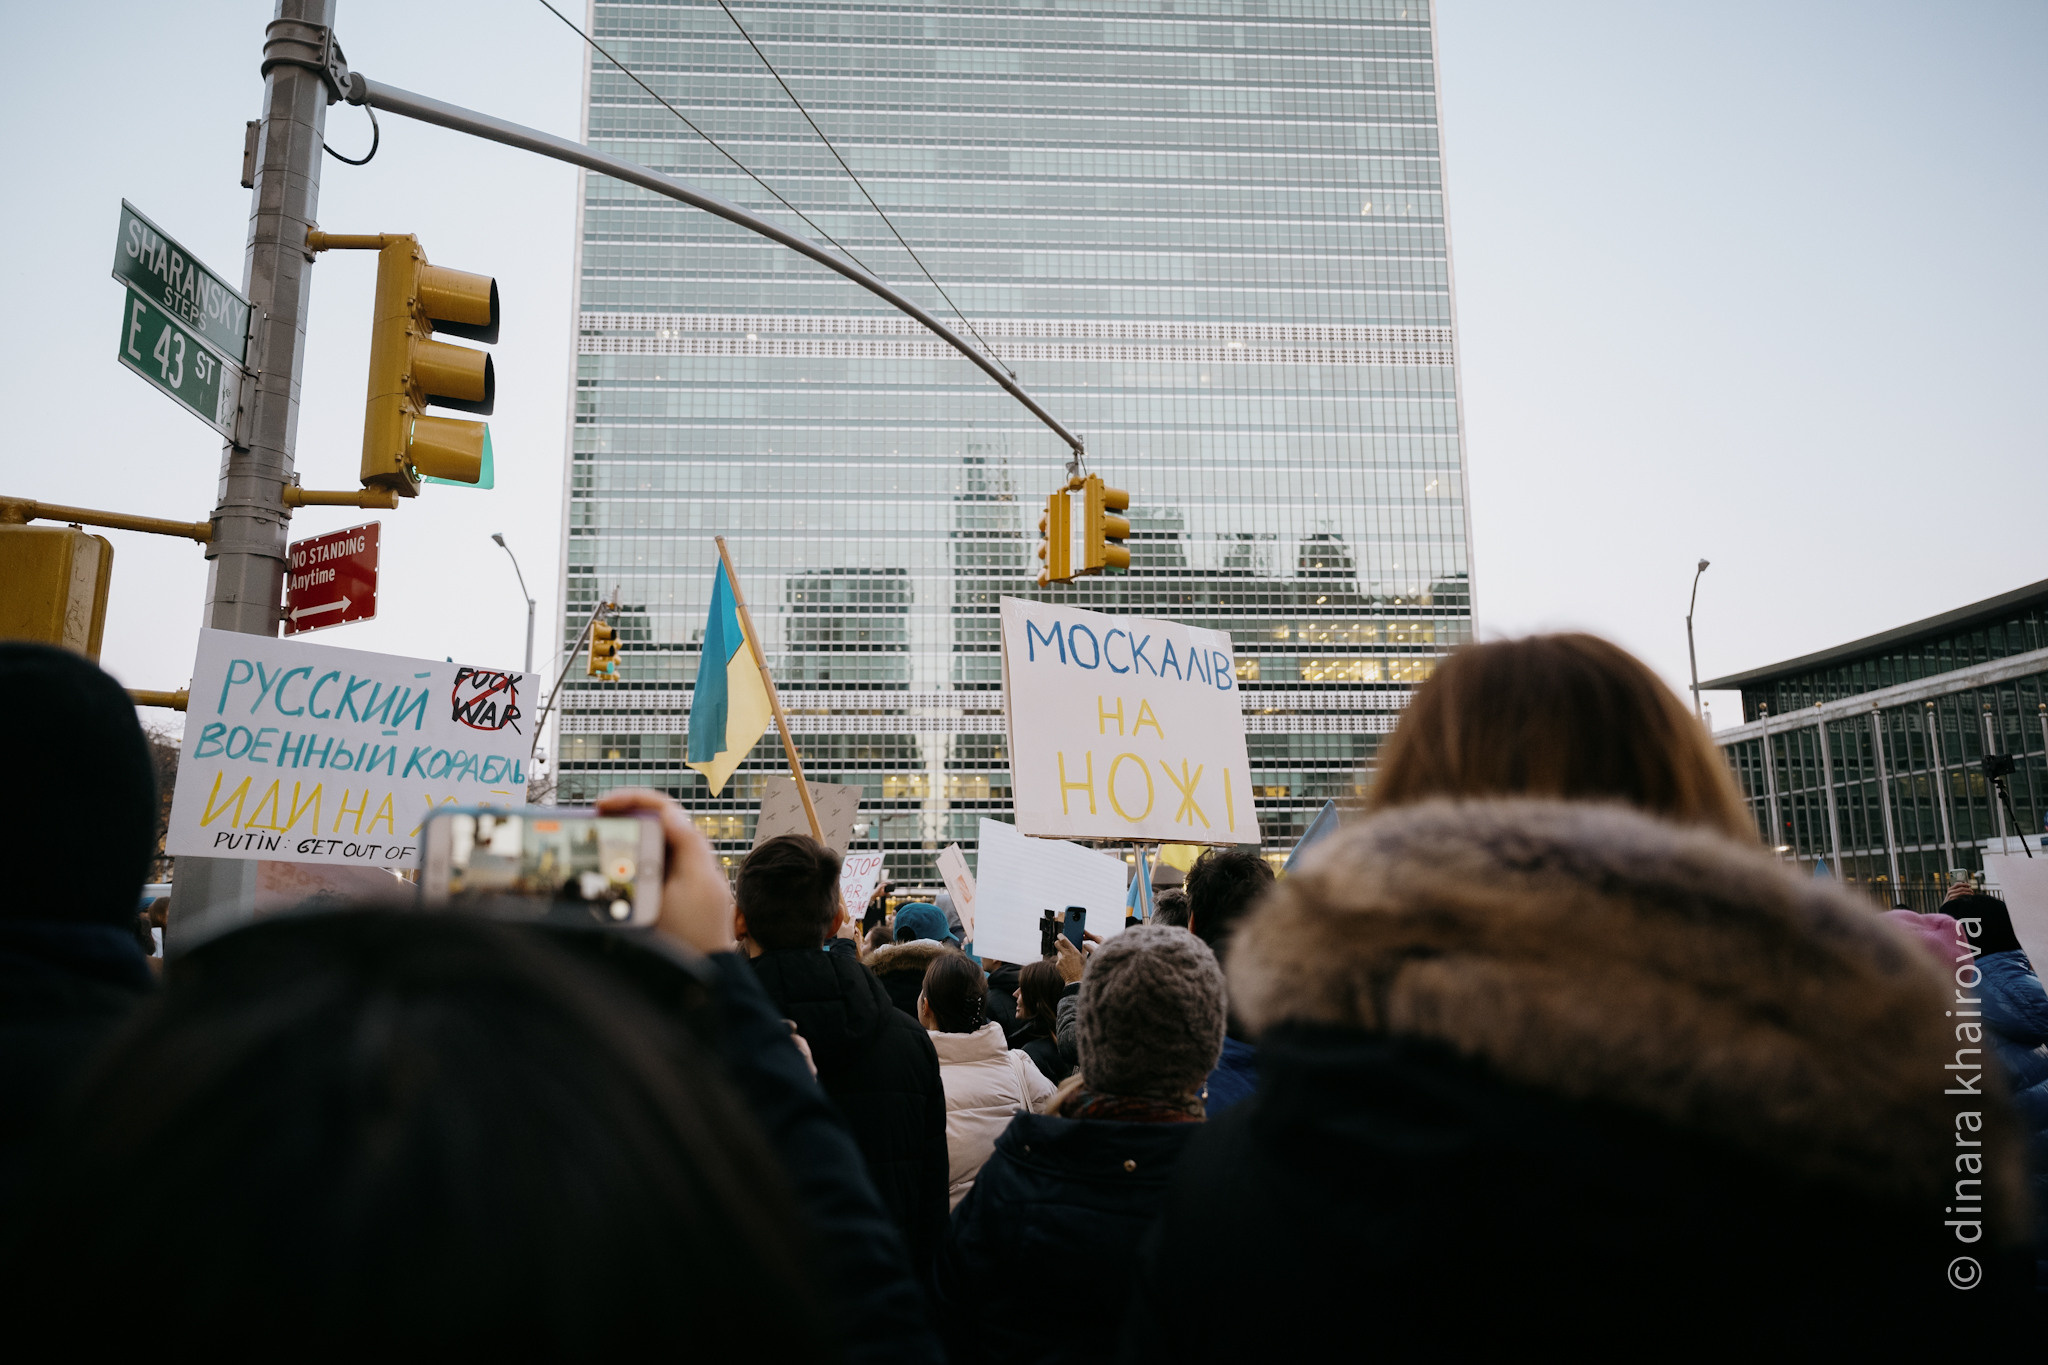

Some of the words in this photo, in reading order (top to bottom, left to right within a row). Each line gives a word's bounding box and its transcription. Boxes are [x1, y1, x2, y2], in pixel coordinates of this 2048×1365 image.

[126, 218, 244, 336] SHARANSKY
[164, 286, 207, 332] STEPS
[127, 298, 146, 361] E
[153, 324, 185, 389] 43
[195, 350, 216, 385] ST
[292, 551, 306, 569] NO
[309, 535, 365, 565] STANDING
[291, 568, 336, 591] Anytime
[217, 659, 431, 730] РУССКИЙ
[453, 667, 522, 695] FUCK
[452, 697, 522, 735] WAR
[1098, 695, 1164, 740] НА
[193, 722, 398, 776] ВОЕННЫЙ
[402, 745, 525, 785] КОРАБЛЬ
[200, 769, 323, 836] ИДИ
[332, 788, 394, 836] НА
[1057, 751, 1234, 833] НОЖІ
[297, 839, 343, 855] GET
[343, 843, 382, 860] OUT
[385, 846, 416, 860] OF
[841, 857, 881, 878] STOP
